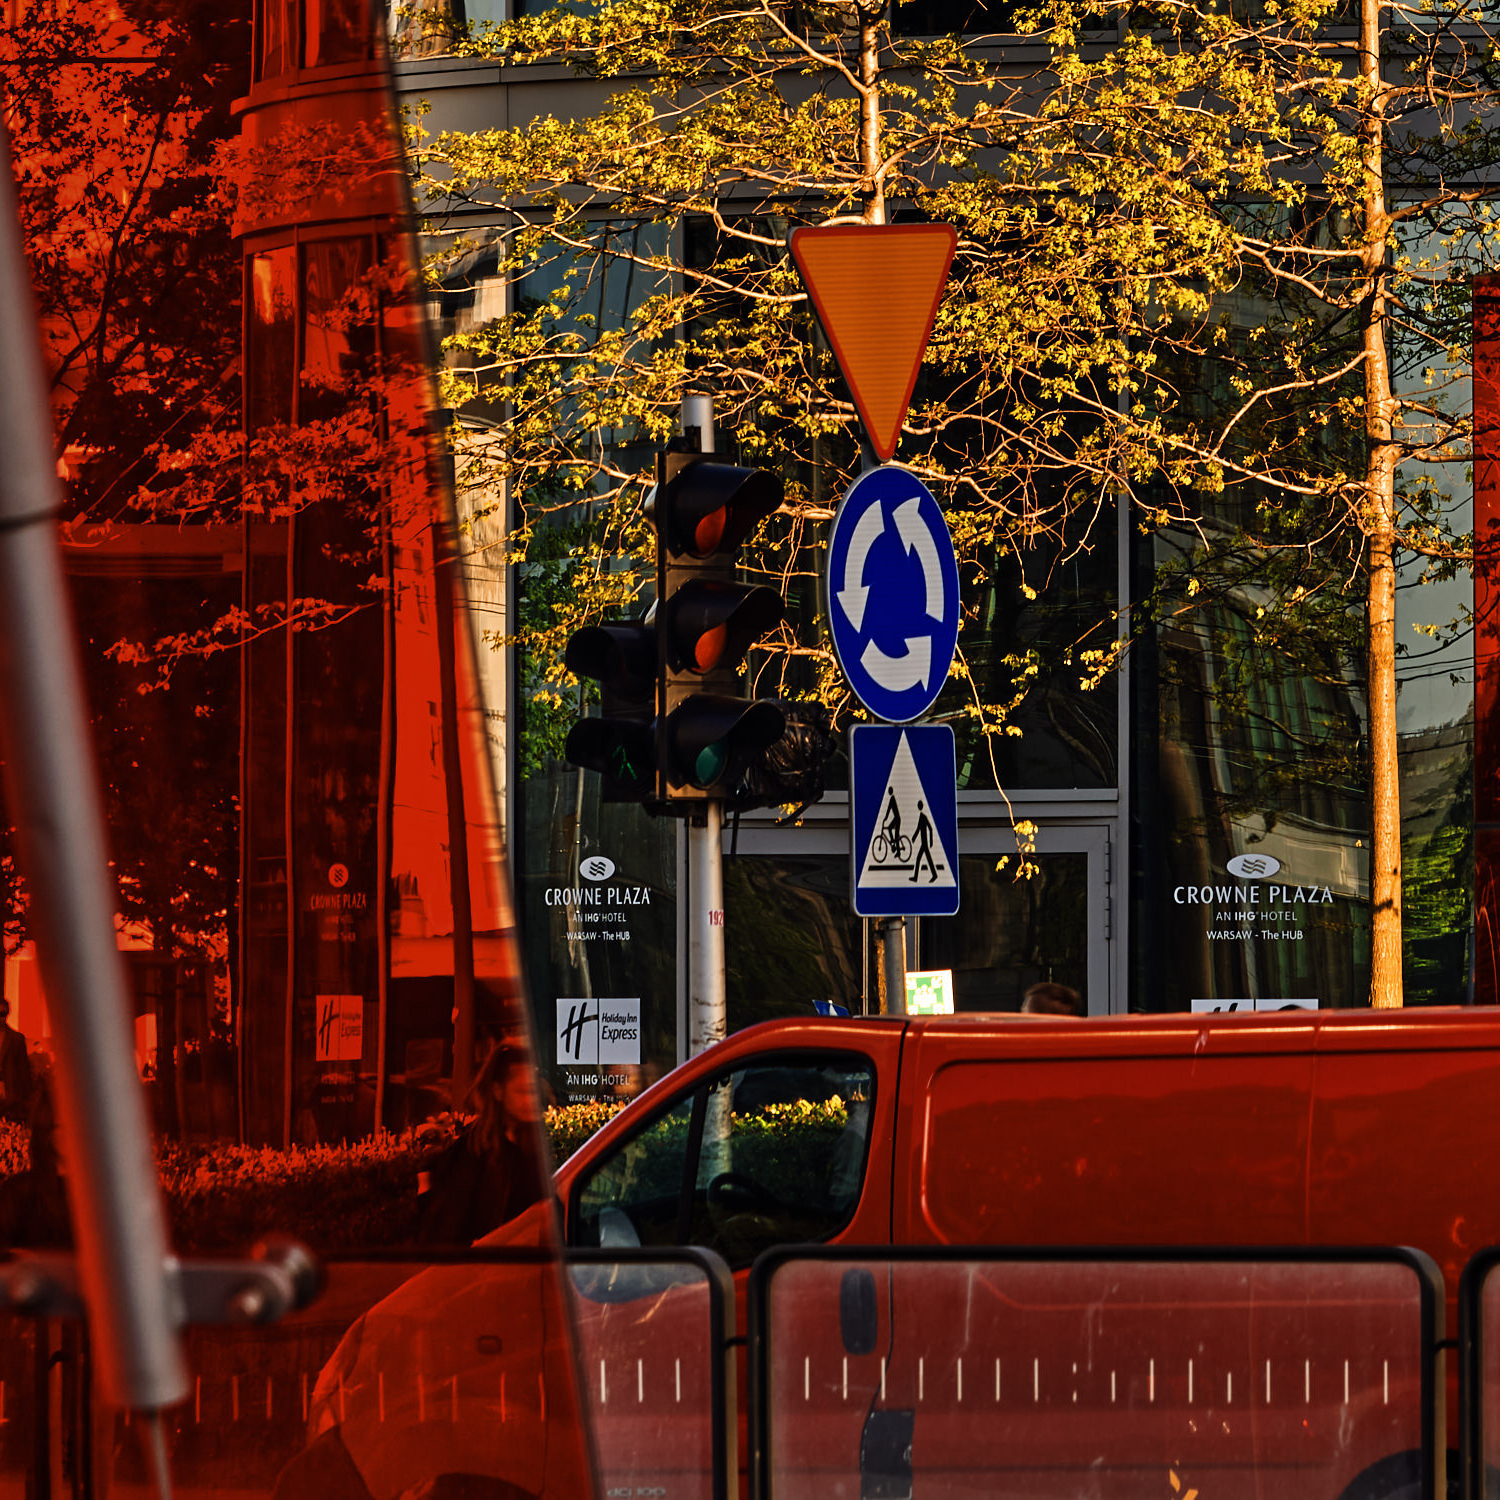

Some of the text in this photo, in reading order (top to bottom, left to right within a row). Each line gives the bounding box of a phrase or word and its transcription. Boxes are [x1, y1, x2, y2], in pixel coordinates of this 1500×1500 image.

[545, 887, 602, 906] CROWNE
[1173, 885, 1260, 904] CROWNE
[602, 912, 627, 923] HOTEL
[1216, 911, 1231, 921] AN
[1261, 911, 1298, 921] HOTEL
[566, 931, 597, 941] WARSAW
[602, 931, 614, 941] The
[615, 931, 630, 941] HUB
[1206, 930, 1253, 940] WARSAW
[1261, 930, 1279, 940] The
[1281, 930, 1303, 940] HUB
[602, 1012, 638, 1026] Holiday Inn
[601, 1025, 638, 1043] Express
[567, 1074, 580, 1085] AN
[601, 1074, 630, 1085] HOTEL
